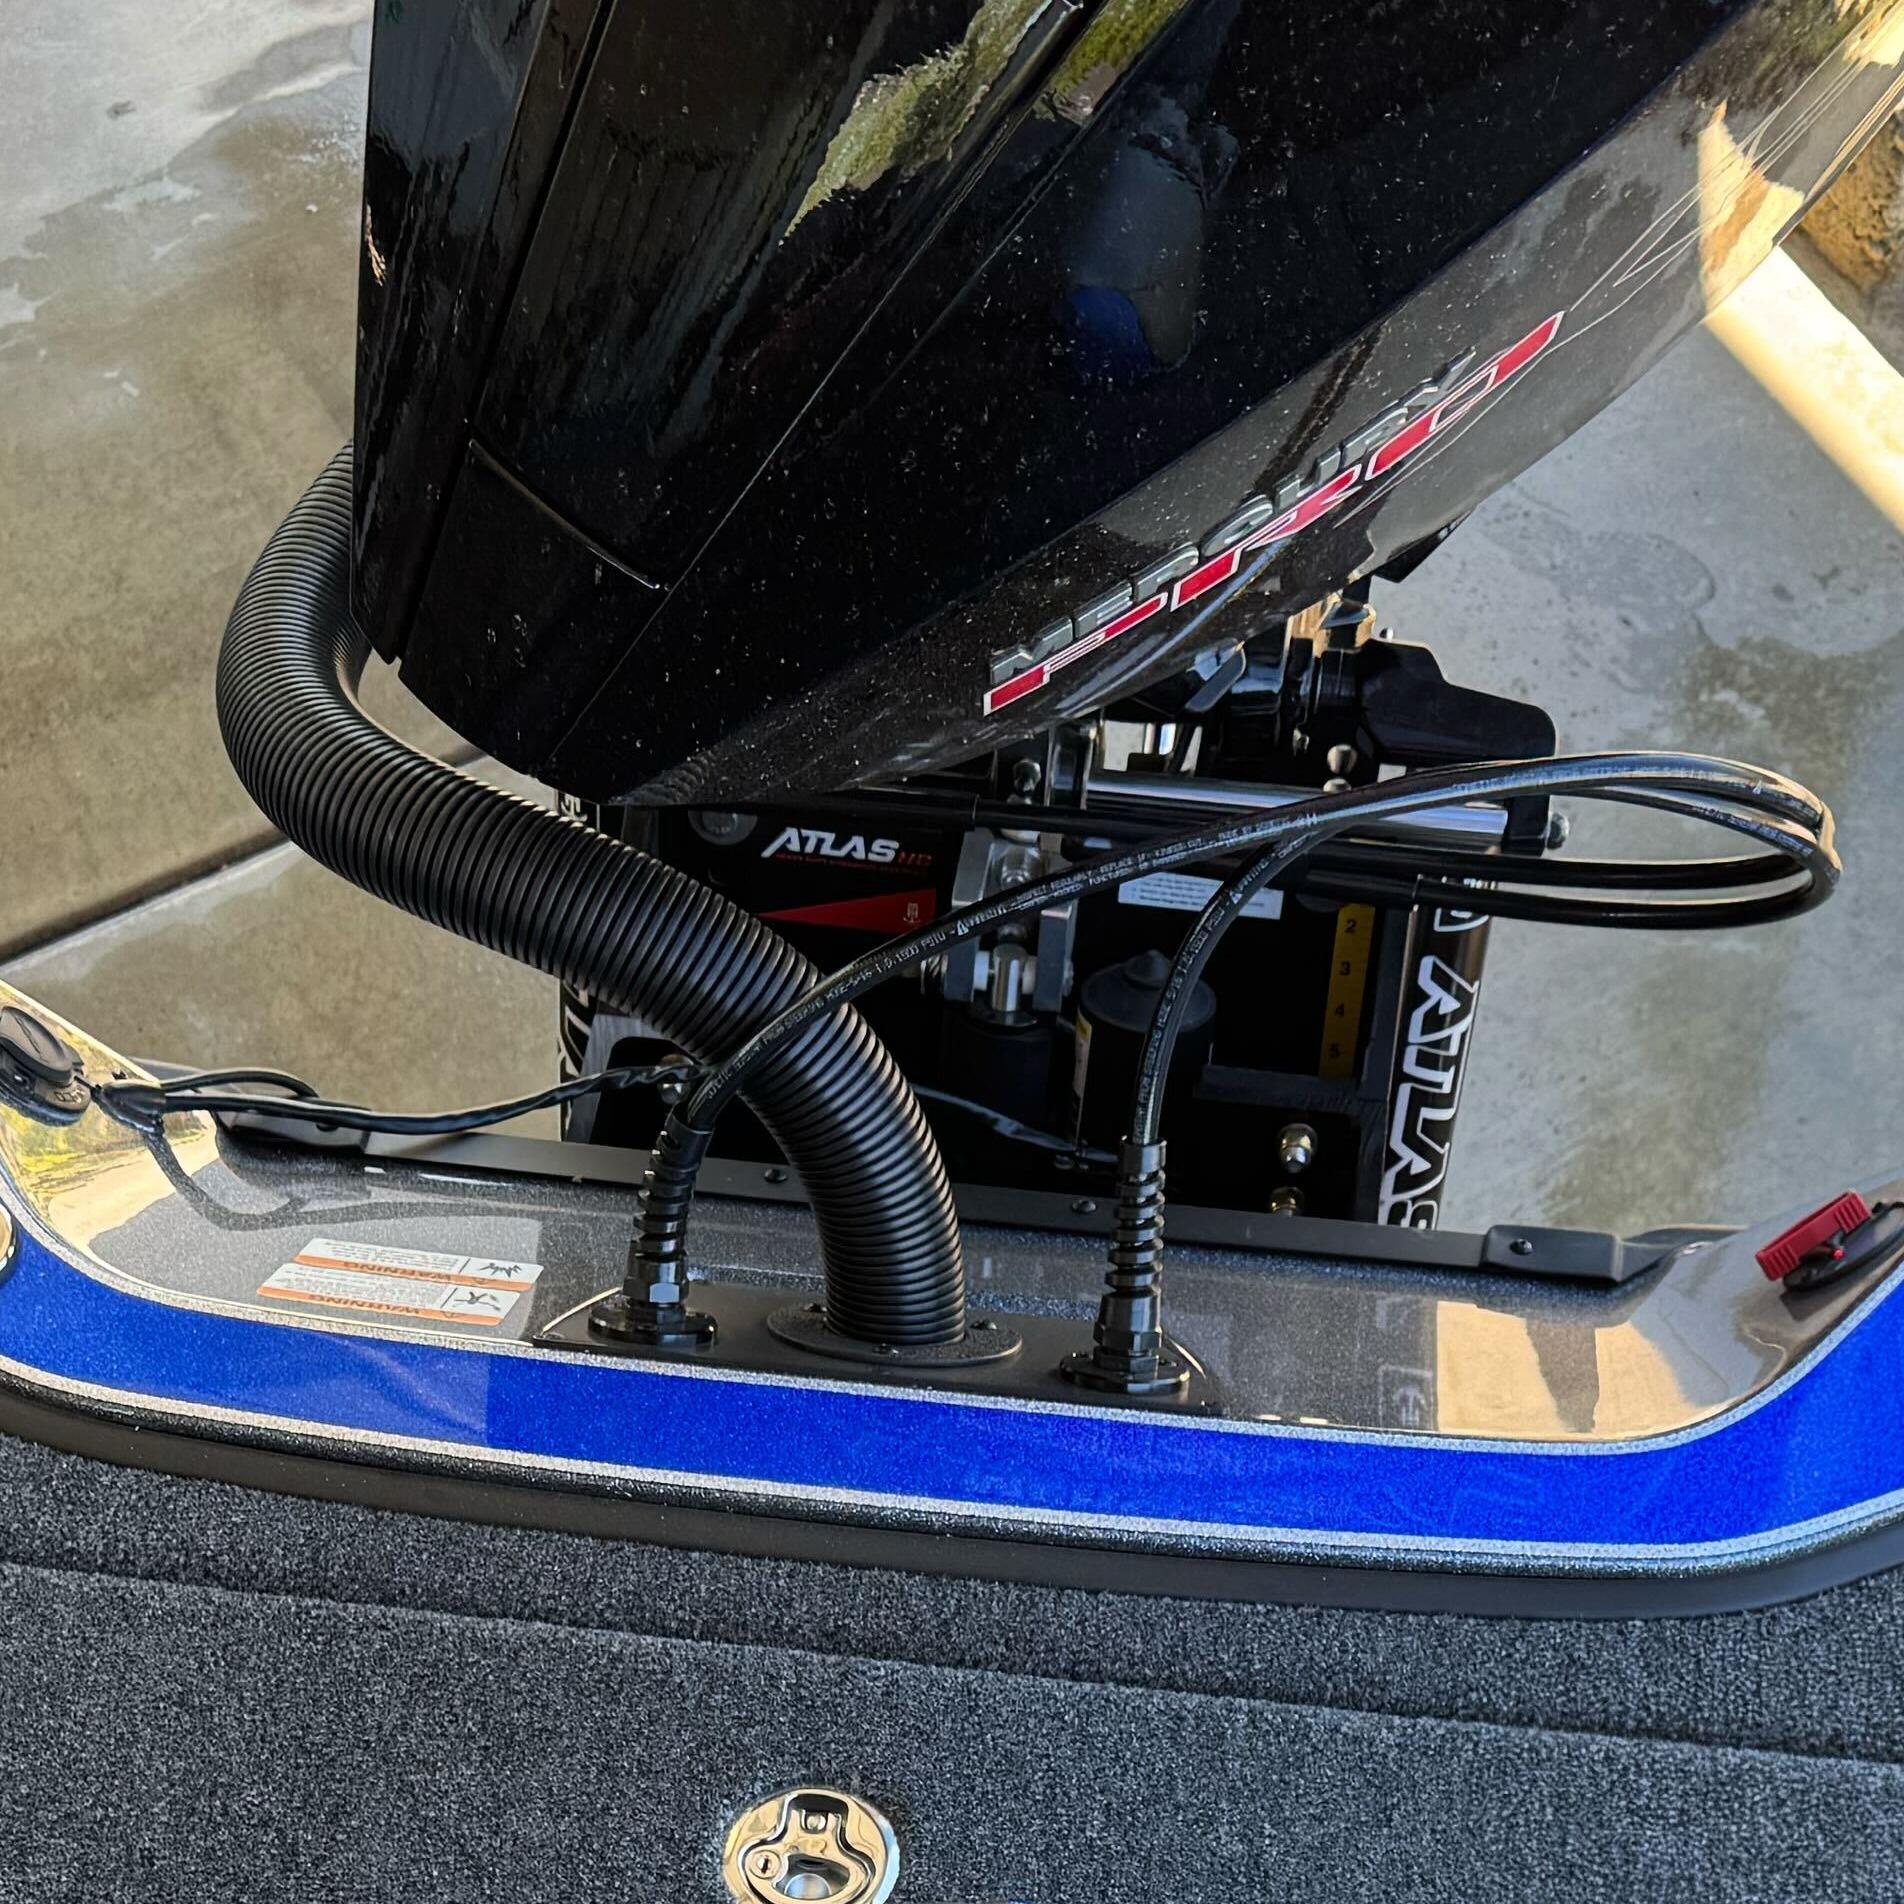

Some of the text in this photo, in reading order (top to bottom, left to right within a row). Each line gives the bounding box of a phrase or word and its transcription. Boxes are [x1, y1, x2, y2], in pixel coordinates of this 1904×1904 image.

[983, 310, 1564, 716] PRO
[990, 347, 1476, 685] MERCURY
[760, 826, 899, 863] ATLAS
[1344, 918, 1357, 934] 2
[1339, 960, 1351, 976] 3
[1334, 1003, 1345, 1017] 4
